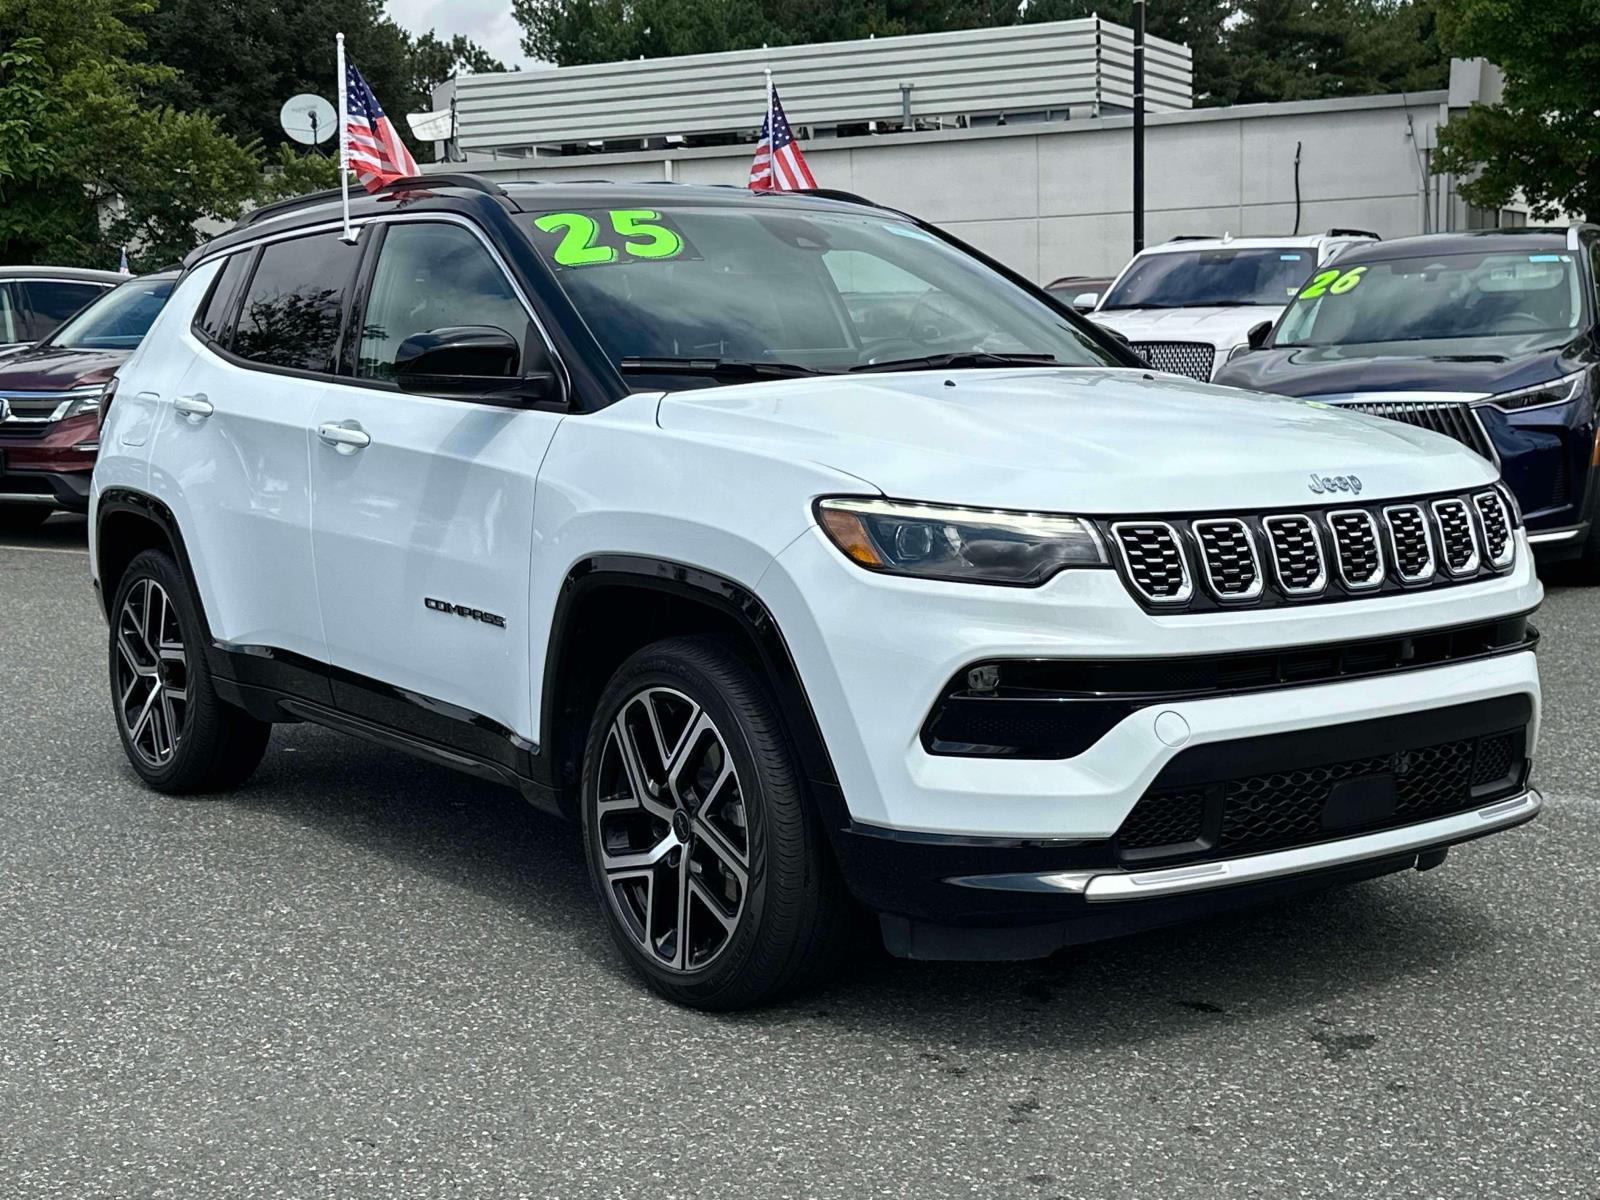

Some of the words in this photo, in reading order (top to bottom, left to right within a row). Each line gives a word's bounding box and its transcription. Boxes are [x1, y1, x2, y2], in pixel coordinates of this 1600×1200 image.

[534, 208, 684, 267] 25
[1298, 266, 1368, 300] 26
[1308, 473, 1363, 496] Jeep
[424, 597, 507, 629] COMPASS
